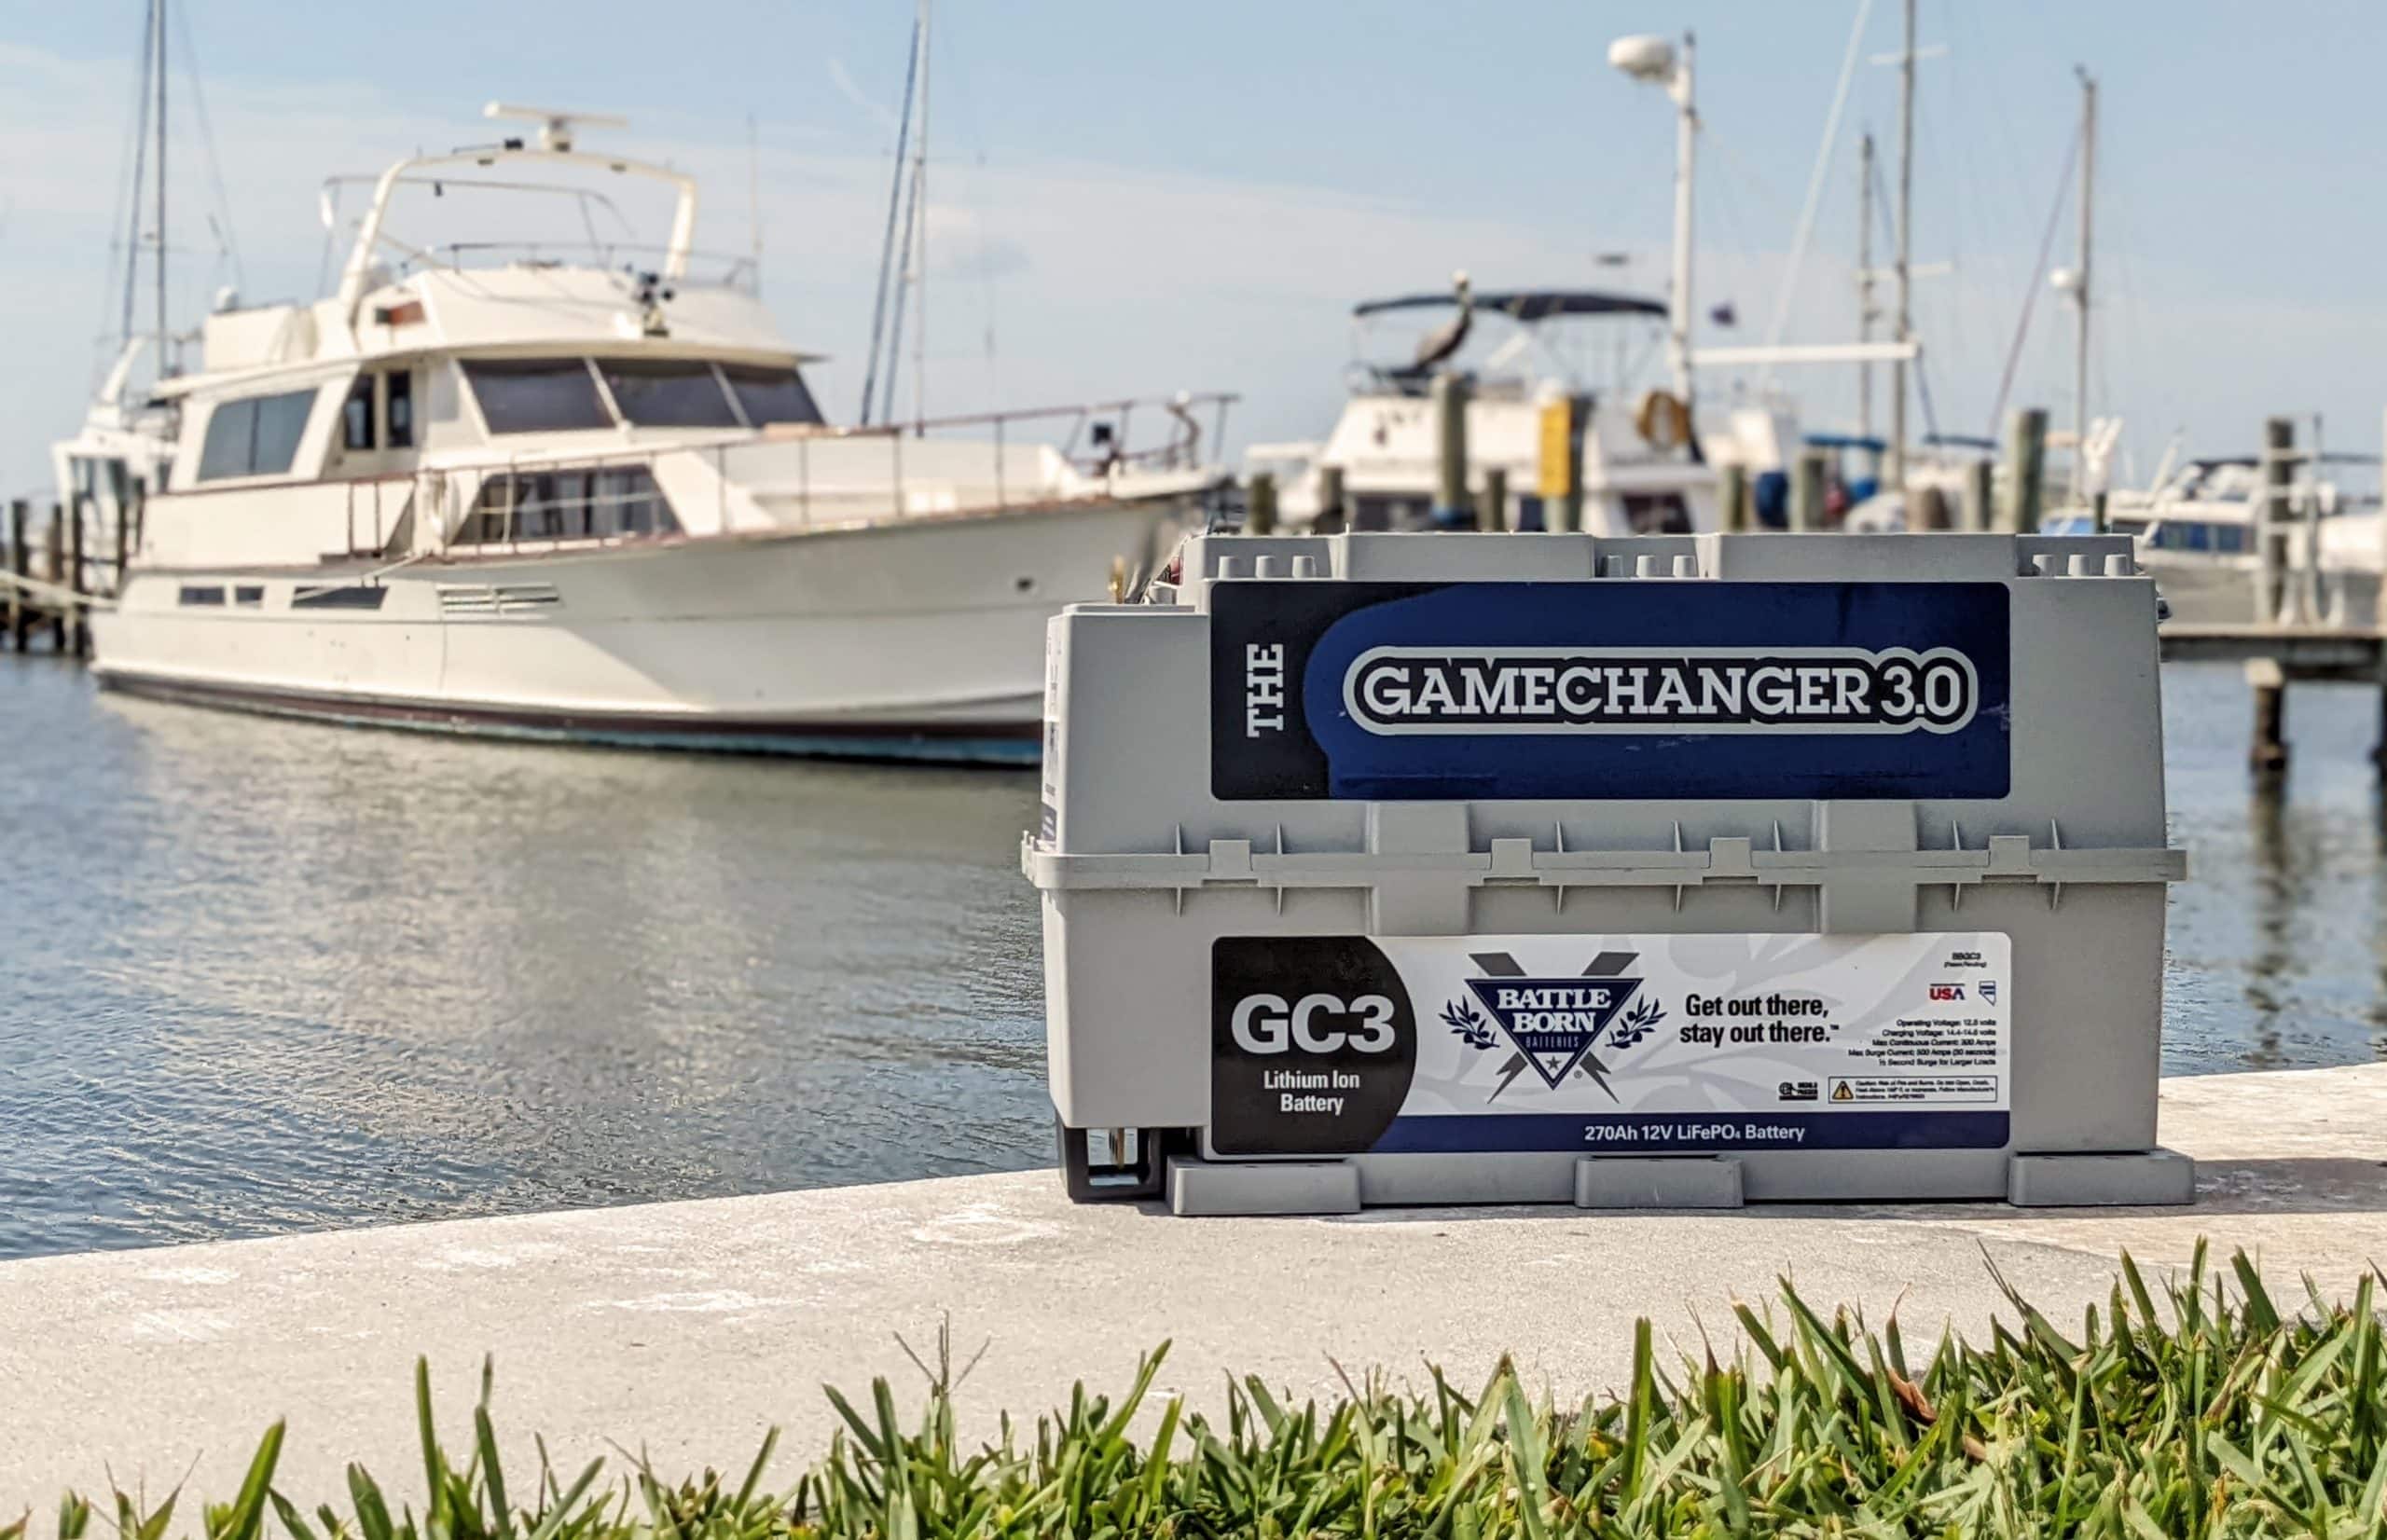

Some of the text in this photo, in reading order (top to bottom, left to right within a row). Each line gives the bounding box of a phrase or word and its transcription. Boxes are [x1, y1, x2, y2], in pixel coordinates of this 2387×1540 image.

[1247, 643, 1283, 737] THE
[1363, 665, 1960, 716] GAMECHANGER 3.0
[1497, 988, 1612, 1010] BATTLE
[1929, 987, 1965, 1000] USA
[1685, 993, 1828, 1019] Get out there,
[1231, 993, 1396, 1054] GC3
[1511, 1011, 1596, 1033] BORN
[1525, 1036, 1580, 1049] BATTERIES
[1679, 1023, 1725, 1048] stay
[1730, 1024, 1764, 1043] out
[1263, 1070, 1360, 1090] Lithium Ion
[1280, 1093, 1345, 1116] Battery
[1584, 1124, 1638, 1141] 270Ah
[1641, 1124, 1674, 1140] 12V
[1745, 1123, 1806, 1144] Battery
